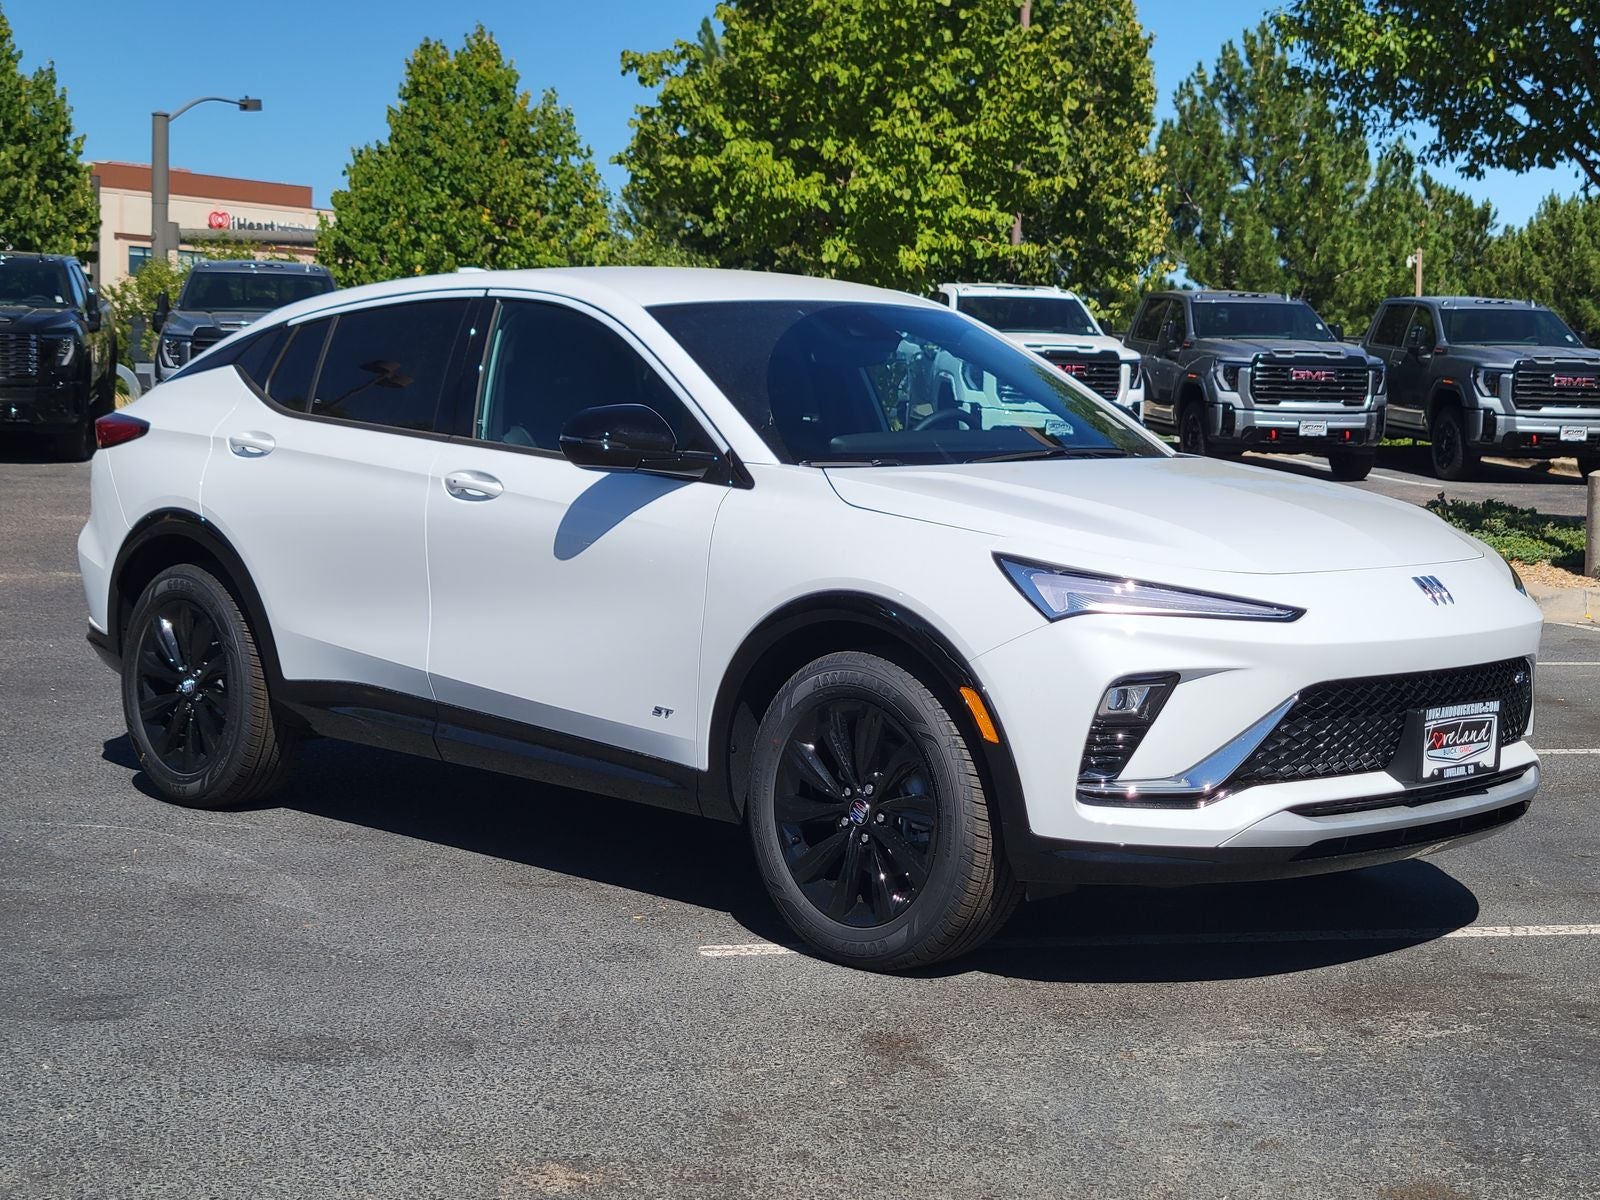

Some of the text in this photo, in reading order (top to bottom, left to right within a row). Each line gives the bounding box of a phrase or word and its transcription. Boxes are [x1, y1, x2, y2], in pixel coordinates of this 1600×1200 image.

[1291, 370, 1336, 381] GMC
[1553, 375, 1596, 387] GMC
[652, 705, 674, 719] ST
[1426, 720, 1490, 749] Loveland
